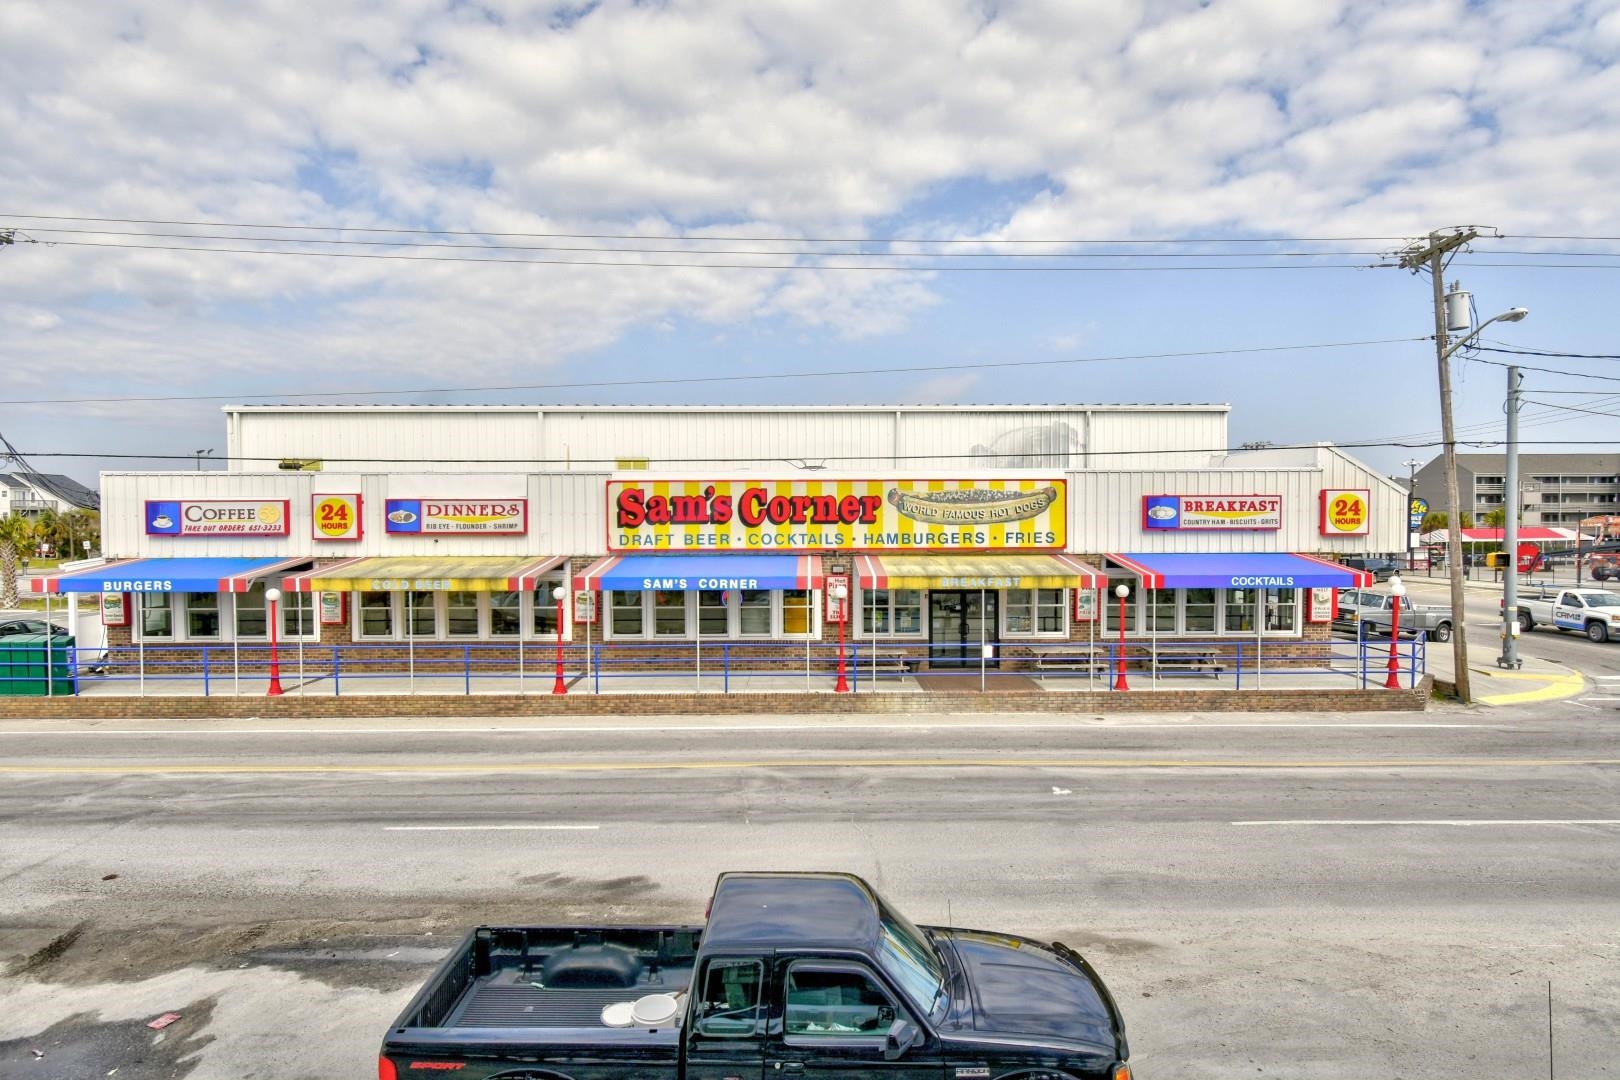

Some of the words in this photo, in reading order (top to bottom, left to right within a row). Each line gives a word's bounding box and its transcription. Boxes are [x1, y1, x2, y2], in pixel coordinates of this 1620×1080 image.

[321, 503, 348, 520] 24
[426, 504, 520, 517] DINNERS
[616, 485, 733, 528] Sam's
[738, 487, 882, 529] Corner
[902, 503, 938, 517] WORLD
[943, 510, 985, 520] FAMOUS
[990, 508, 1010, 518] HOT
[1015, 499, 1045, 514] DOGS
[1184, 500, 1278, 512] BREAKFAST
[1335, 499, 1361, 516] 24
[184, 505, 256, 522] COFFEE
[619, 534, 675, 546] DRAFT
[684, 533, 730, 545] BEER
[748, 533, 845, 545] COCKTAILS
[864, 532, 985, 544] HAMBURGERS
[1005, 532, 1055, 544] FRIES
[103, 581, 172, 591] BURGERS
[415, 580, 451, 590] BEER
[643, 579, 688, 589] SAM'S
[698, 579, 758, 589] CORNER
[942, 577, 1020, 587] BREAKFAST
[1231, 576, 1294, 586] COCKTAILS
[409, 1060, 466, 1070] SPORT
